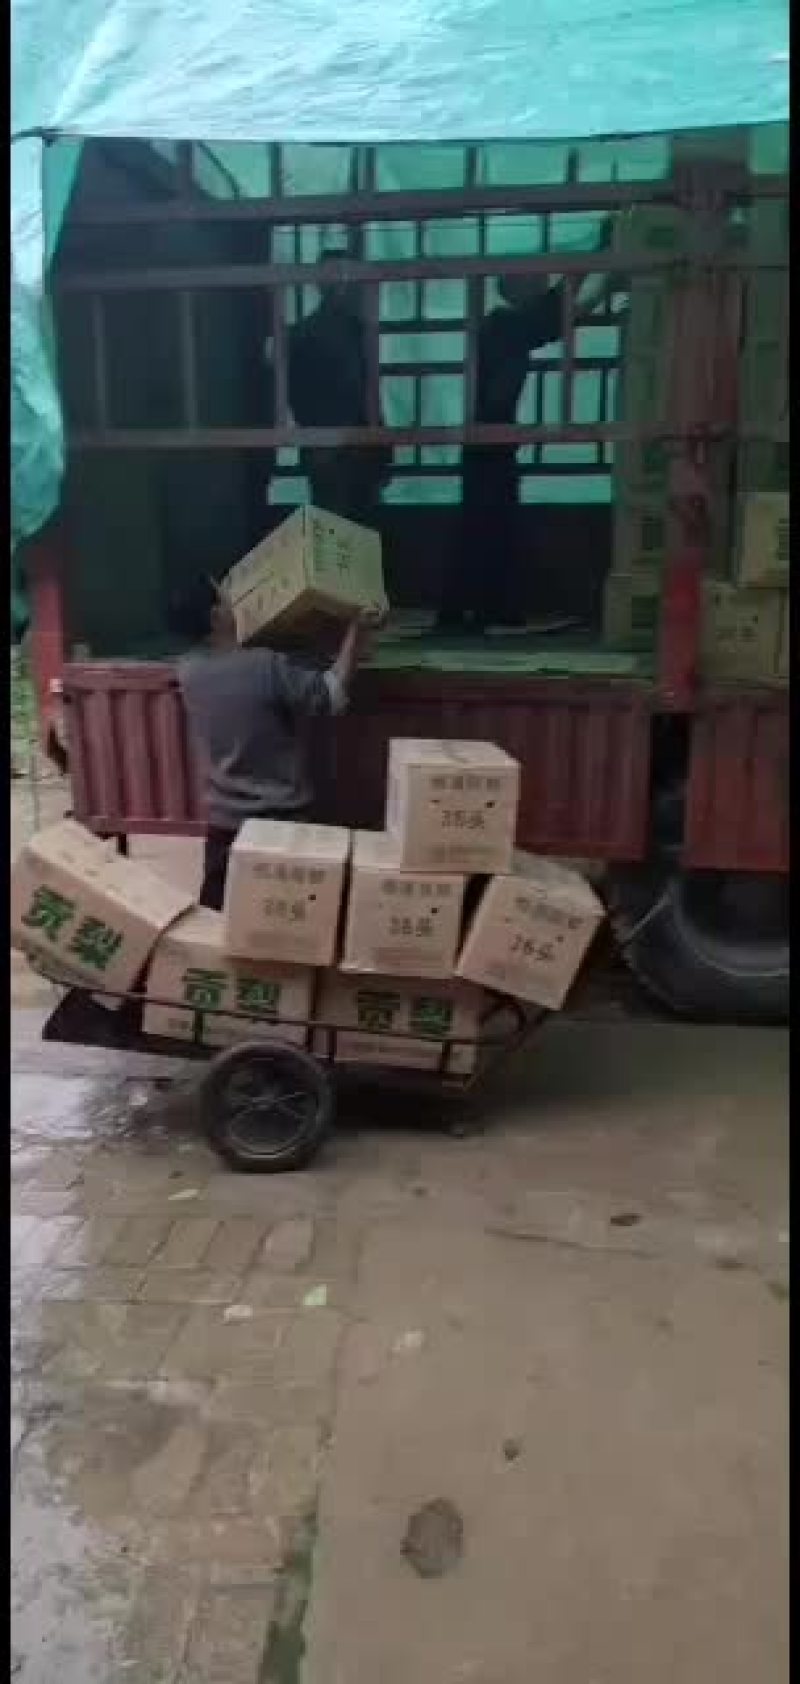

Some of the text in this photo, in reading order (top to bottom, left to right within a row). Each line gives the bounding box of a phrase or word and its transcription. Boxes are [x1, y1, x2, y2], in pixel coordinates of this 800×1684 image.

[21, 884, 123, 971] 贡梨
[184, 967, 281, 1014] 贡梨
[357, 991, 454, 1034] 贡梨
